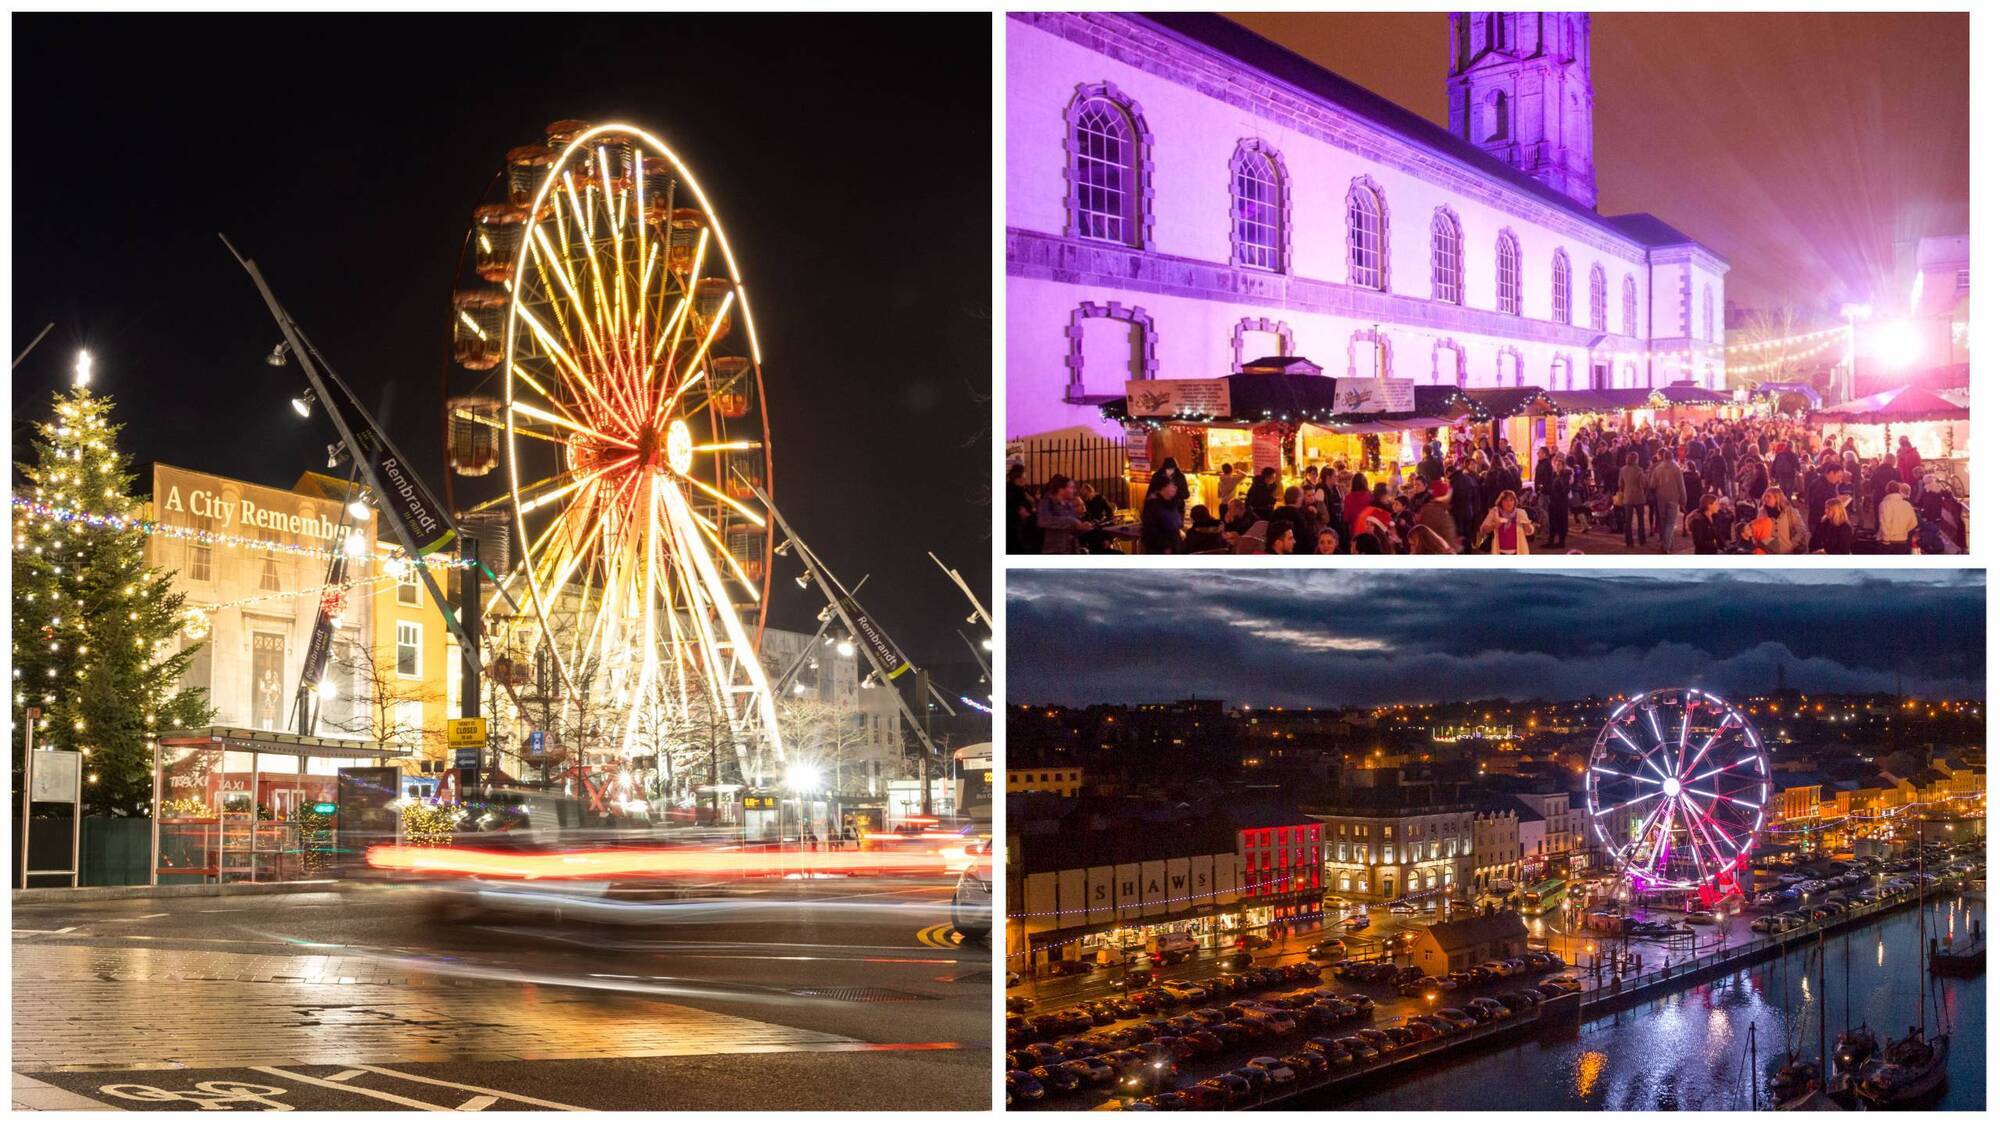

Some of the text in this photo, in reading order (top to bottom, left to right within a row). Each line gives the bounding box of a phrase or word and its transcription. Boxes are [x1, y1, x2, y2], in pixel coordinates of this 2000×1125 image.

[165, 486, 184, 512] A
[190, 490, 235, 528] City
[382, 458, 437, 534] Rembrandt
[857, 616, 897, 666] Rembrandt
[456, 726, 477, 735] CLOSED
[1096, 873, 1206, 899] SHAWS
